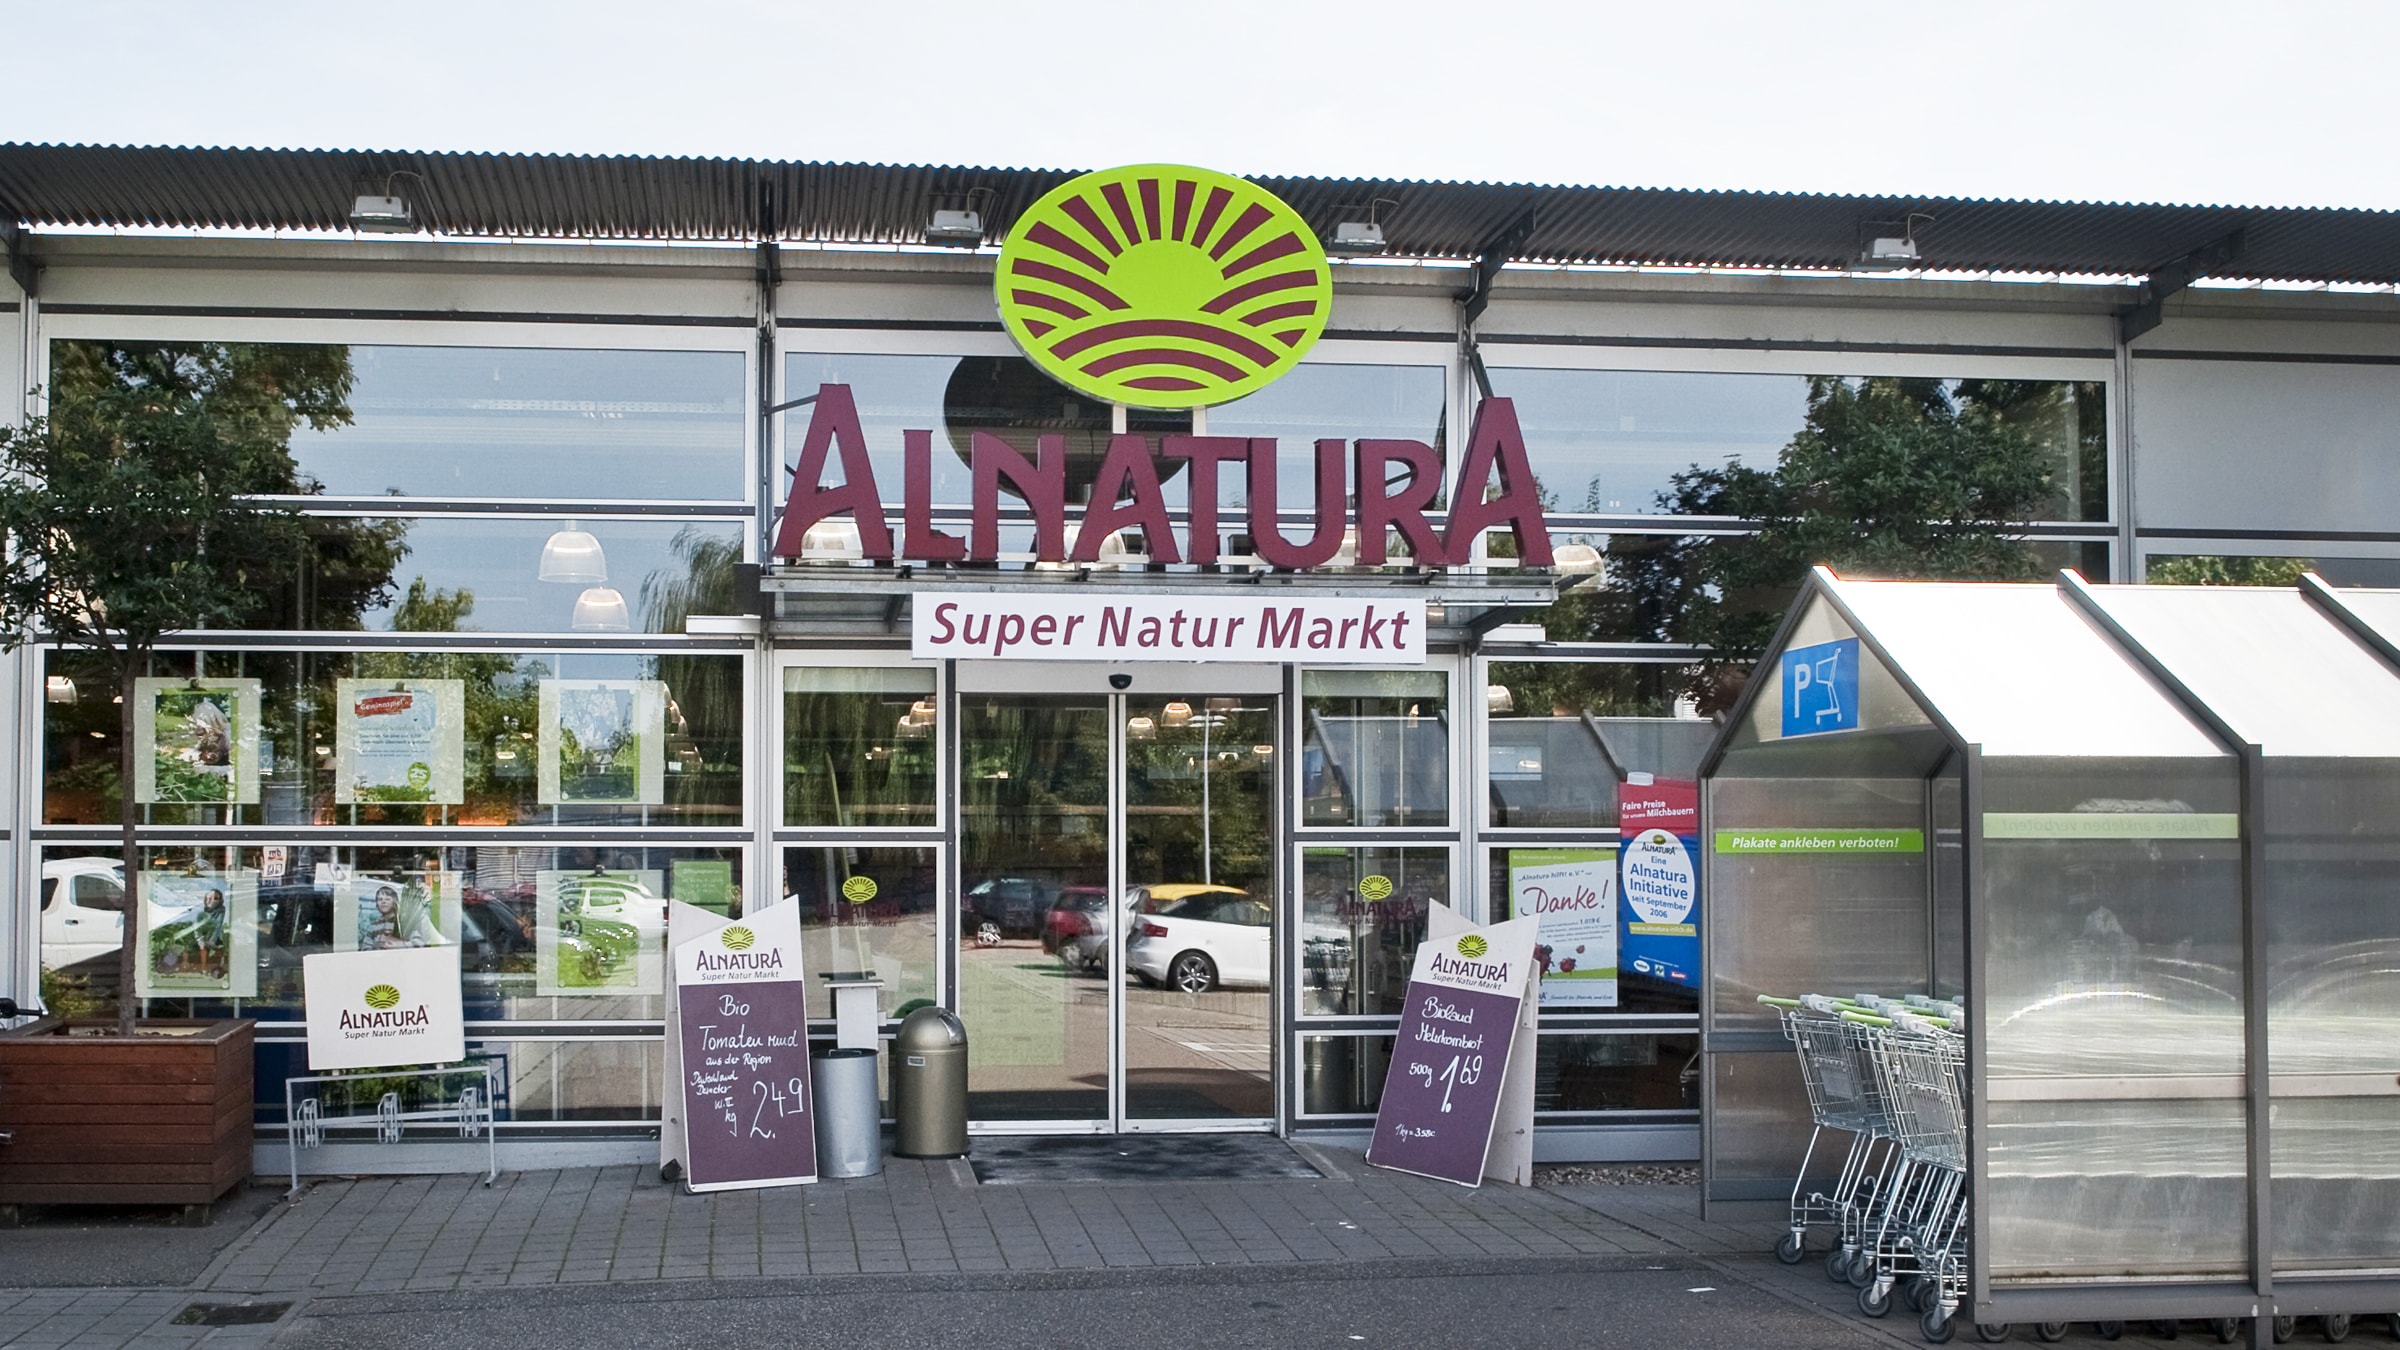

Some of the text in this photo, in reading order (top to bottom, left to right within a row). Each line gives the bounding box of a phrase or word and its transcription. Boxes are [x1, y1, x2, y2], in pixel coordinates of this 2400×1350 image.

[770, 384, 1555, 569] ALNATURA
[930, 602, 1410, 656] Super Natur Markt
[1794, 663, 1811, 718] P
[1622, 800, 1666, 811] Faire Preise
[1646, 807, 1694, 818] Milchbauern
[1732, 837, 1899, 848] Plakate ankleben verboten!
[1651, 856, 1667, 865] Eine
[1630, 863, 1688, 884] Alnatura
[1520, 879, 1609, 917] Danke!
[1630, 878, 1688, 900] Initiative
[1632, 895, 1687, 911] seit September
[1650, 908, 1668, 918] 2006
[696, 947, 783, 971] ALNATURA
[1430, 952, 1507, 983] ALNATURA
[701, 970, 779, 982] Super Natur Markt
[1432, 972, 1502, 991] Super Natur Markt
[719, 994, 750, 1016] Bio
[1421, 996, 1474, 1025] Bioland
[339, 1004, 429, 1030] ALNATURA
[344, 1027, 425, 1040] Super Natur Markt
[705, 1052, 772, 1072] aus der Region
[1408, 1062, 1433, 1088] 500g
[724, 1108, 738, 1138] kg
